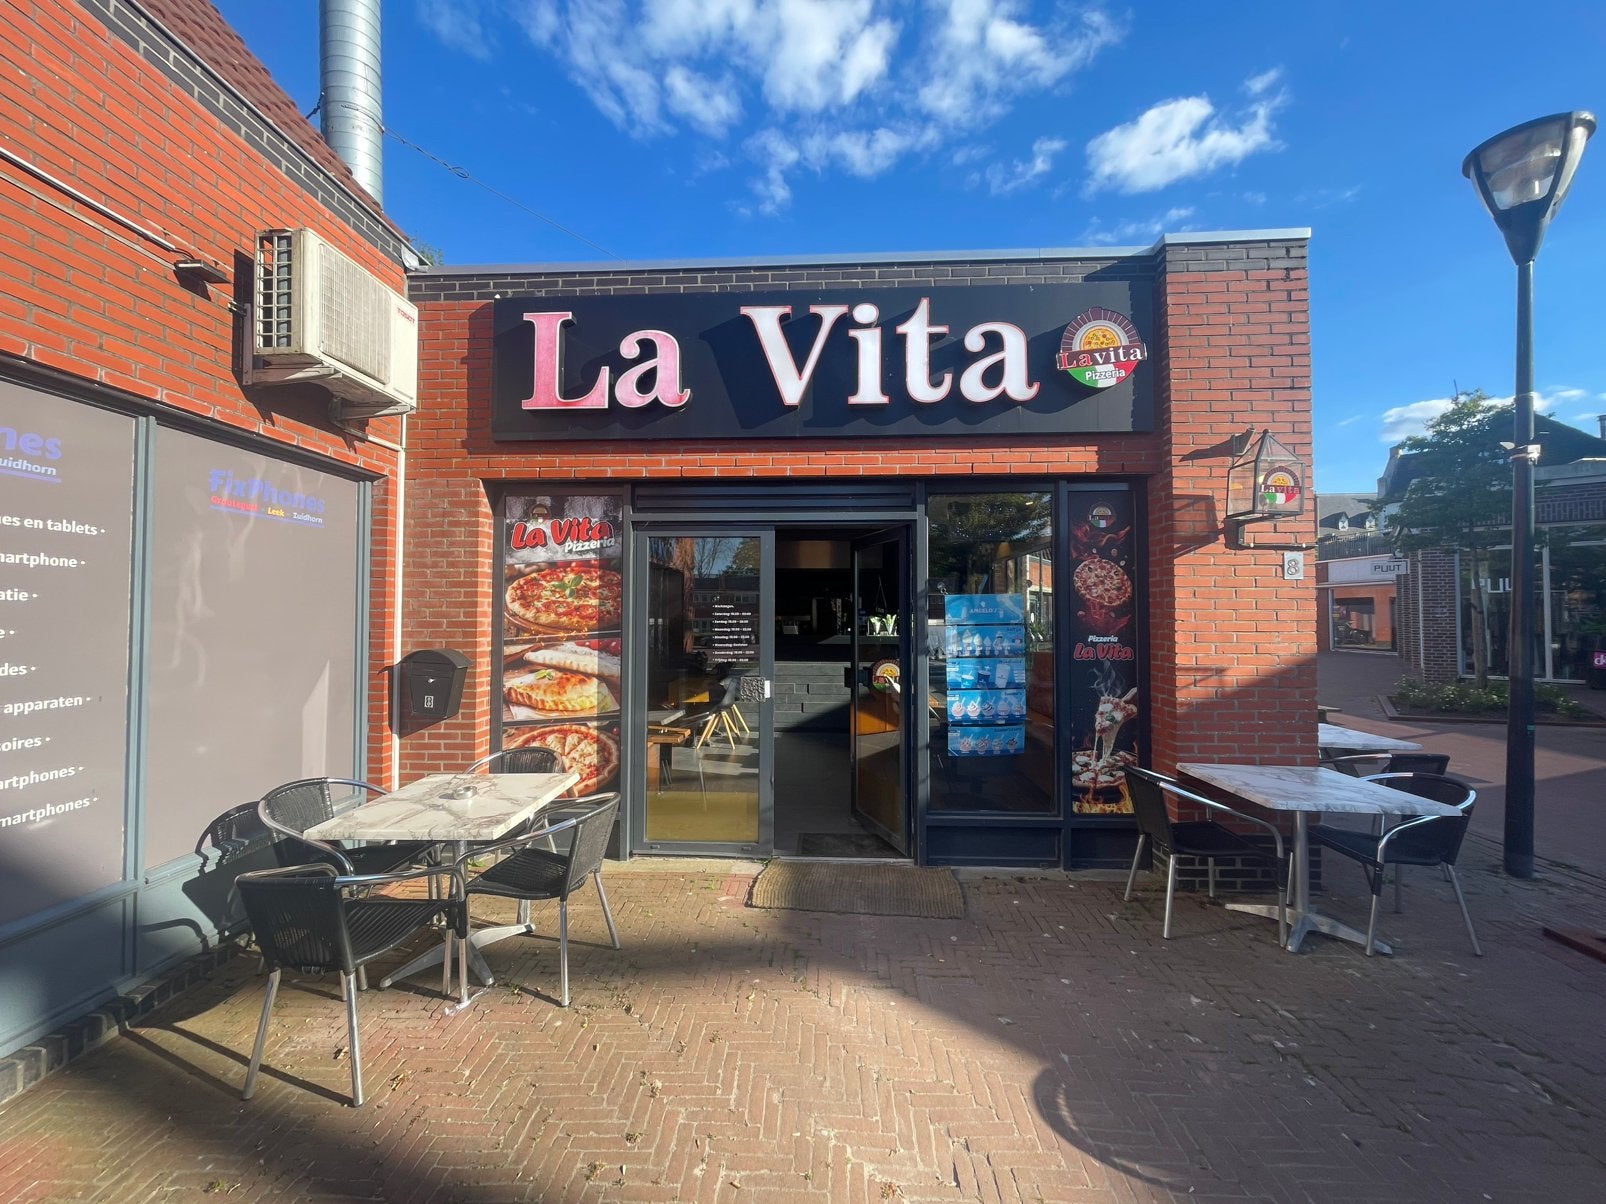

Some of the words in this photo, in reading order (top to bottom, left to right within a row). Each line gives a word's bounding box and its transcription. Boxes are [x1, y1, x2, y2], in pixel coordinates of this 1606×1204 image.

[521, 311, 691, 410] La
[740, 297, 1041, 406] Vita
[1085, 368, 1126, 380] Pizzeria
[267, 507, 285, 517] Leek
[293, 512, 323, 523] Zuidhorn
[0, 515, 21, 526] es
[23, 518, 43, 529] en
[47, 519, 98, 535] tablets
[511, 521, 548, 551] La
[550, 517, 613, 545] Vita
[1286, 559, 1299, 576] 8
[1074, 643, 1096, 660] La
[1097, 643, 1134, 660] Vita
[3, 696, 83, 716] apparaten
[0, 737, 42, 752] oires
